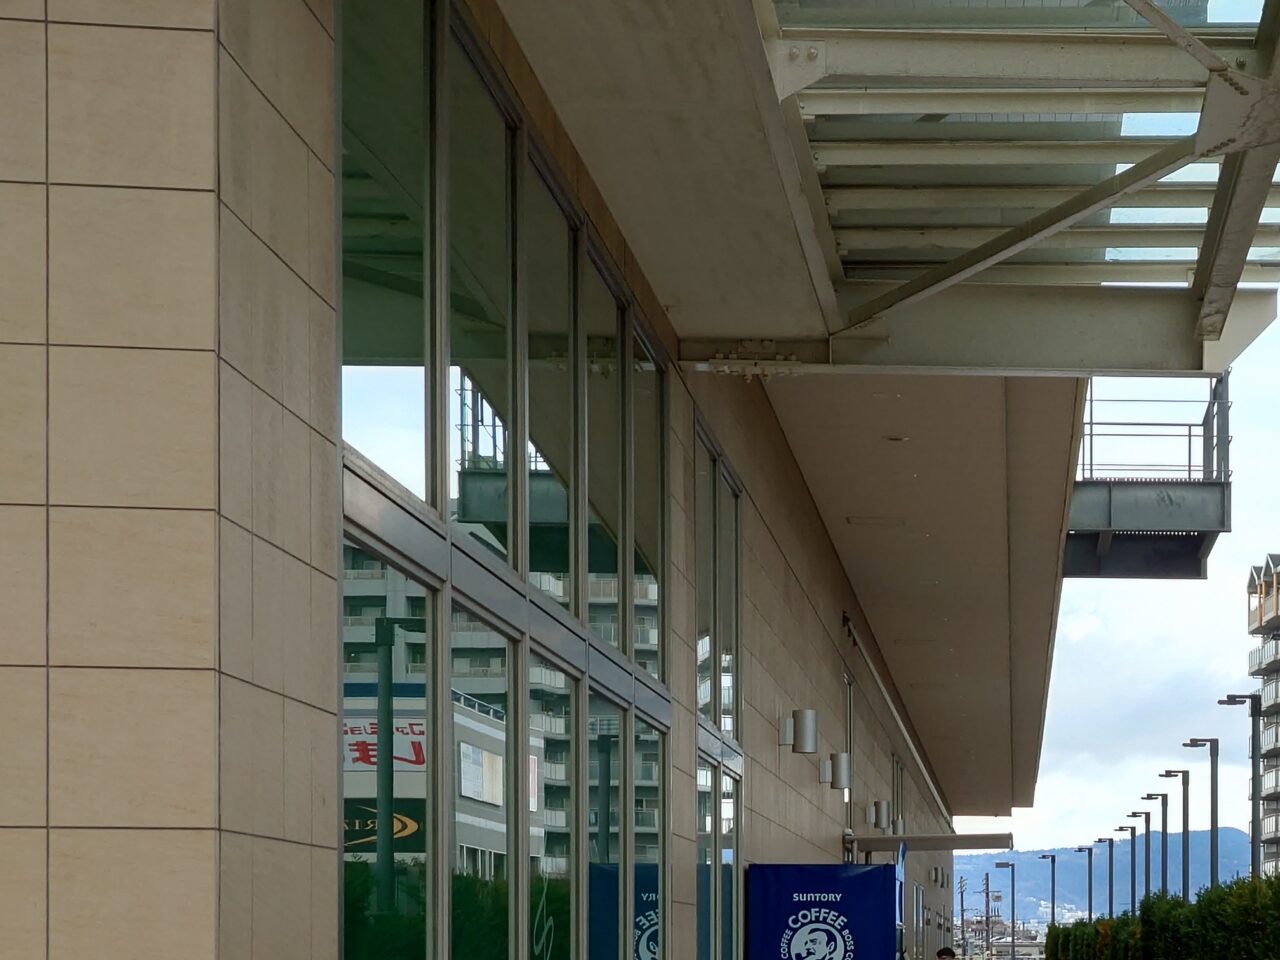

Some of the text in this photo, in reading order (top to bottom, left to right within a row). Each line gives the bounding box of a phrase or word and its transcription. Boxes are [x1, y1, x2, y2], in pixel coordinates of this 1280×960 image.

[792, 893, 842, 902] SUNTORY
[788, 908, 848, 929] COFFEE
[780, 928, 793, 959] COFFEE
[841, 929, 855, 950] BOSS
